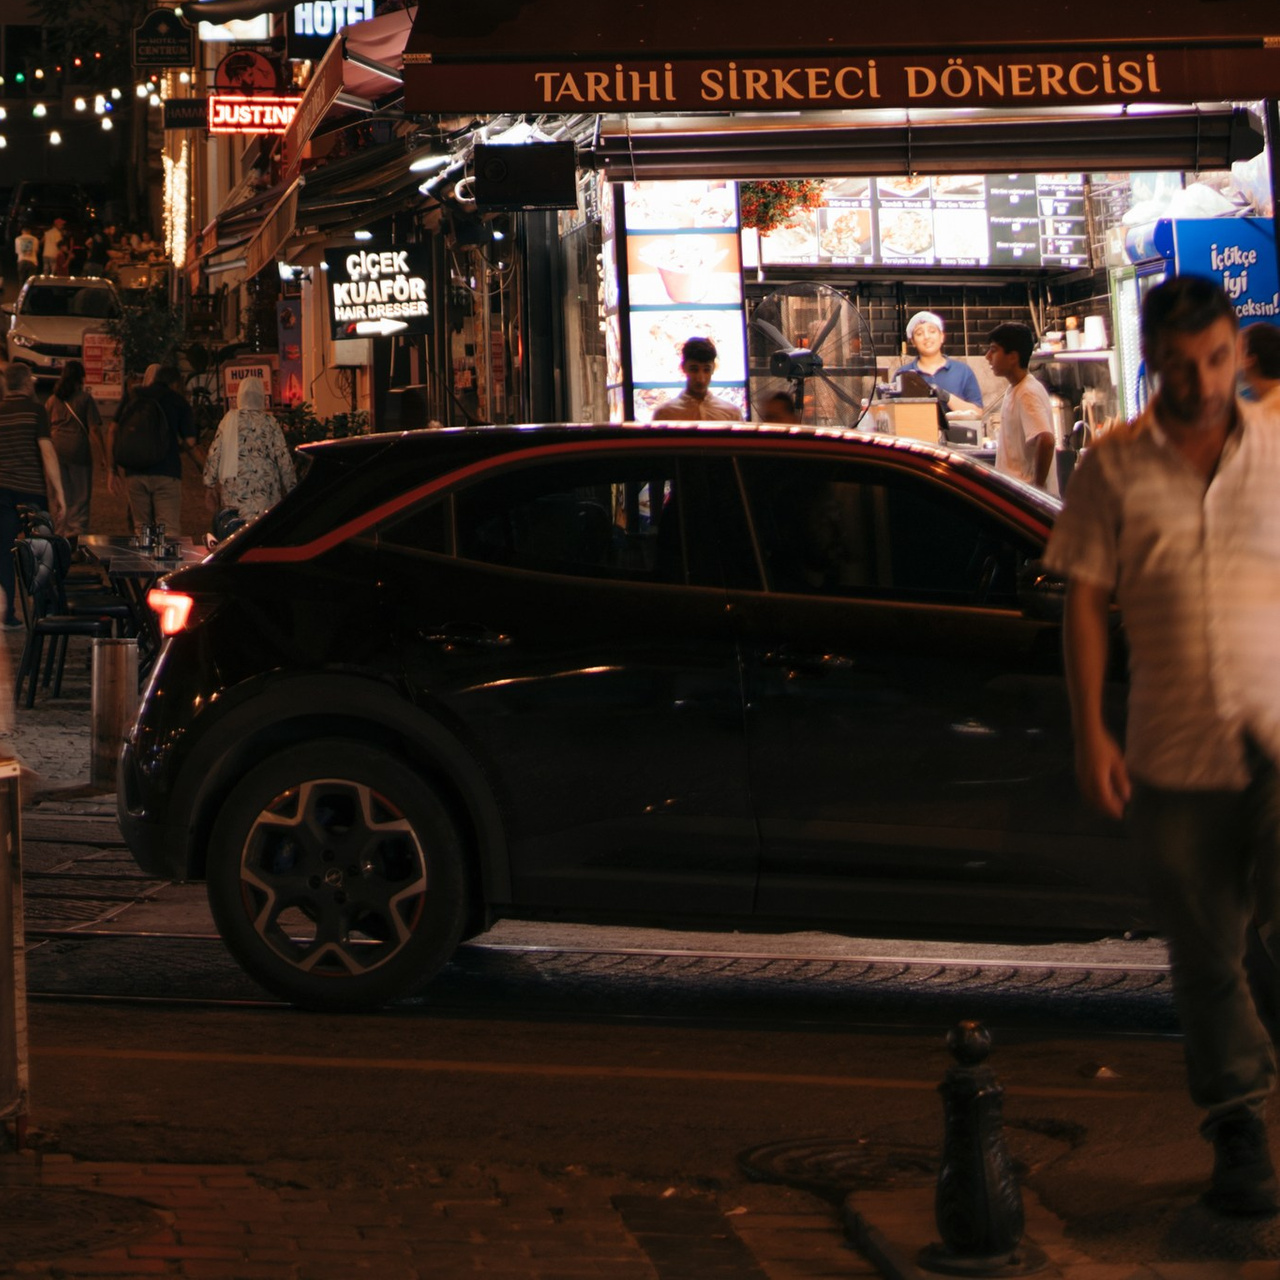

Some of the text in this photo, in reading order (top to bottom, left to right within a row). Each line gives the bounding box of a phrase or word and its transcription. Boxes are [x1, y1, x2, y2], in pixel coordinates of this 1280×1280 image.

[138, 46, 188, 55] CENTRUM
[535, 53, 1160, 103] TARİHİ SİRKECİ DÖNERCİSİ
[346, 250, 410, 281] ÇİÇEK
[1210, 243, 1257, 271] İçtikçe
[333, 274, 427, 307] KUAFÖR
[1233, 292, 1280, 317] ceksin!
[334, 300, 429, 321] HAIR DRESSER
